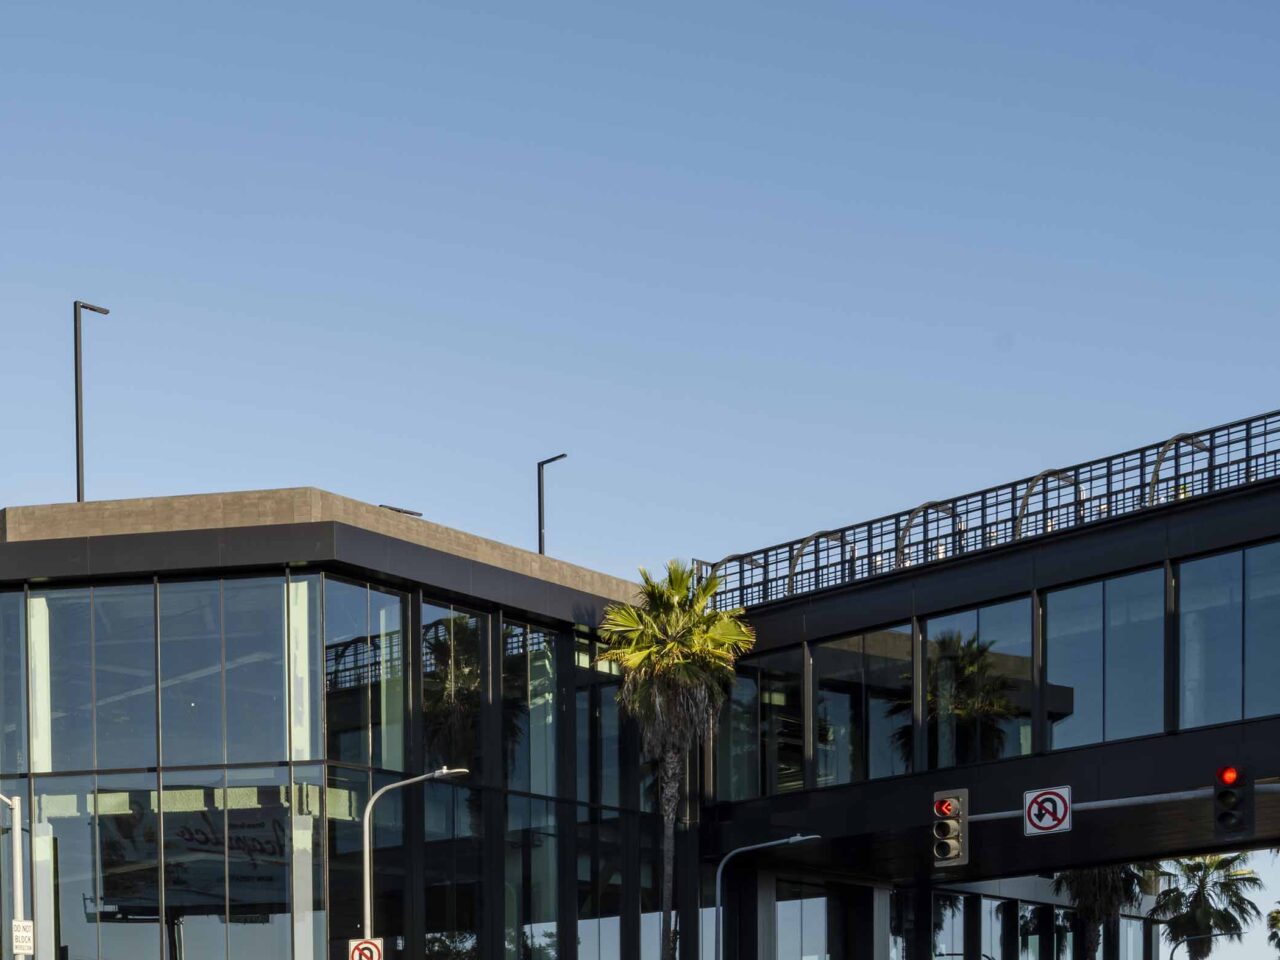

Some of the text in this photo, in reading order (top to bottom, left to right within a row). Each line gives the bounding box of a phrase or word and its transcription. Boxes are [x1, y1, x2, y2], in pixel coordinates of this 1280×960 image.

[14, 924, 32, 933] DO NOT
[14, 934, 31, 943] BLOCK
